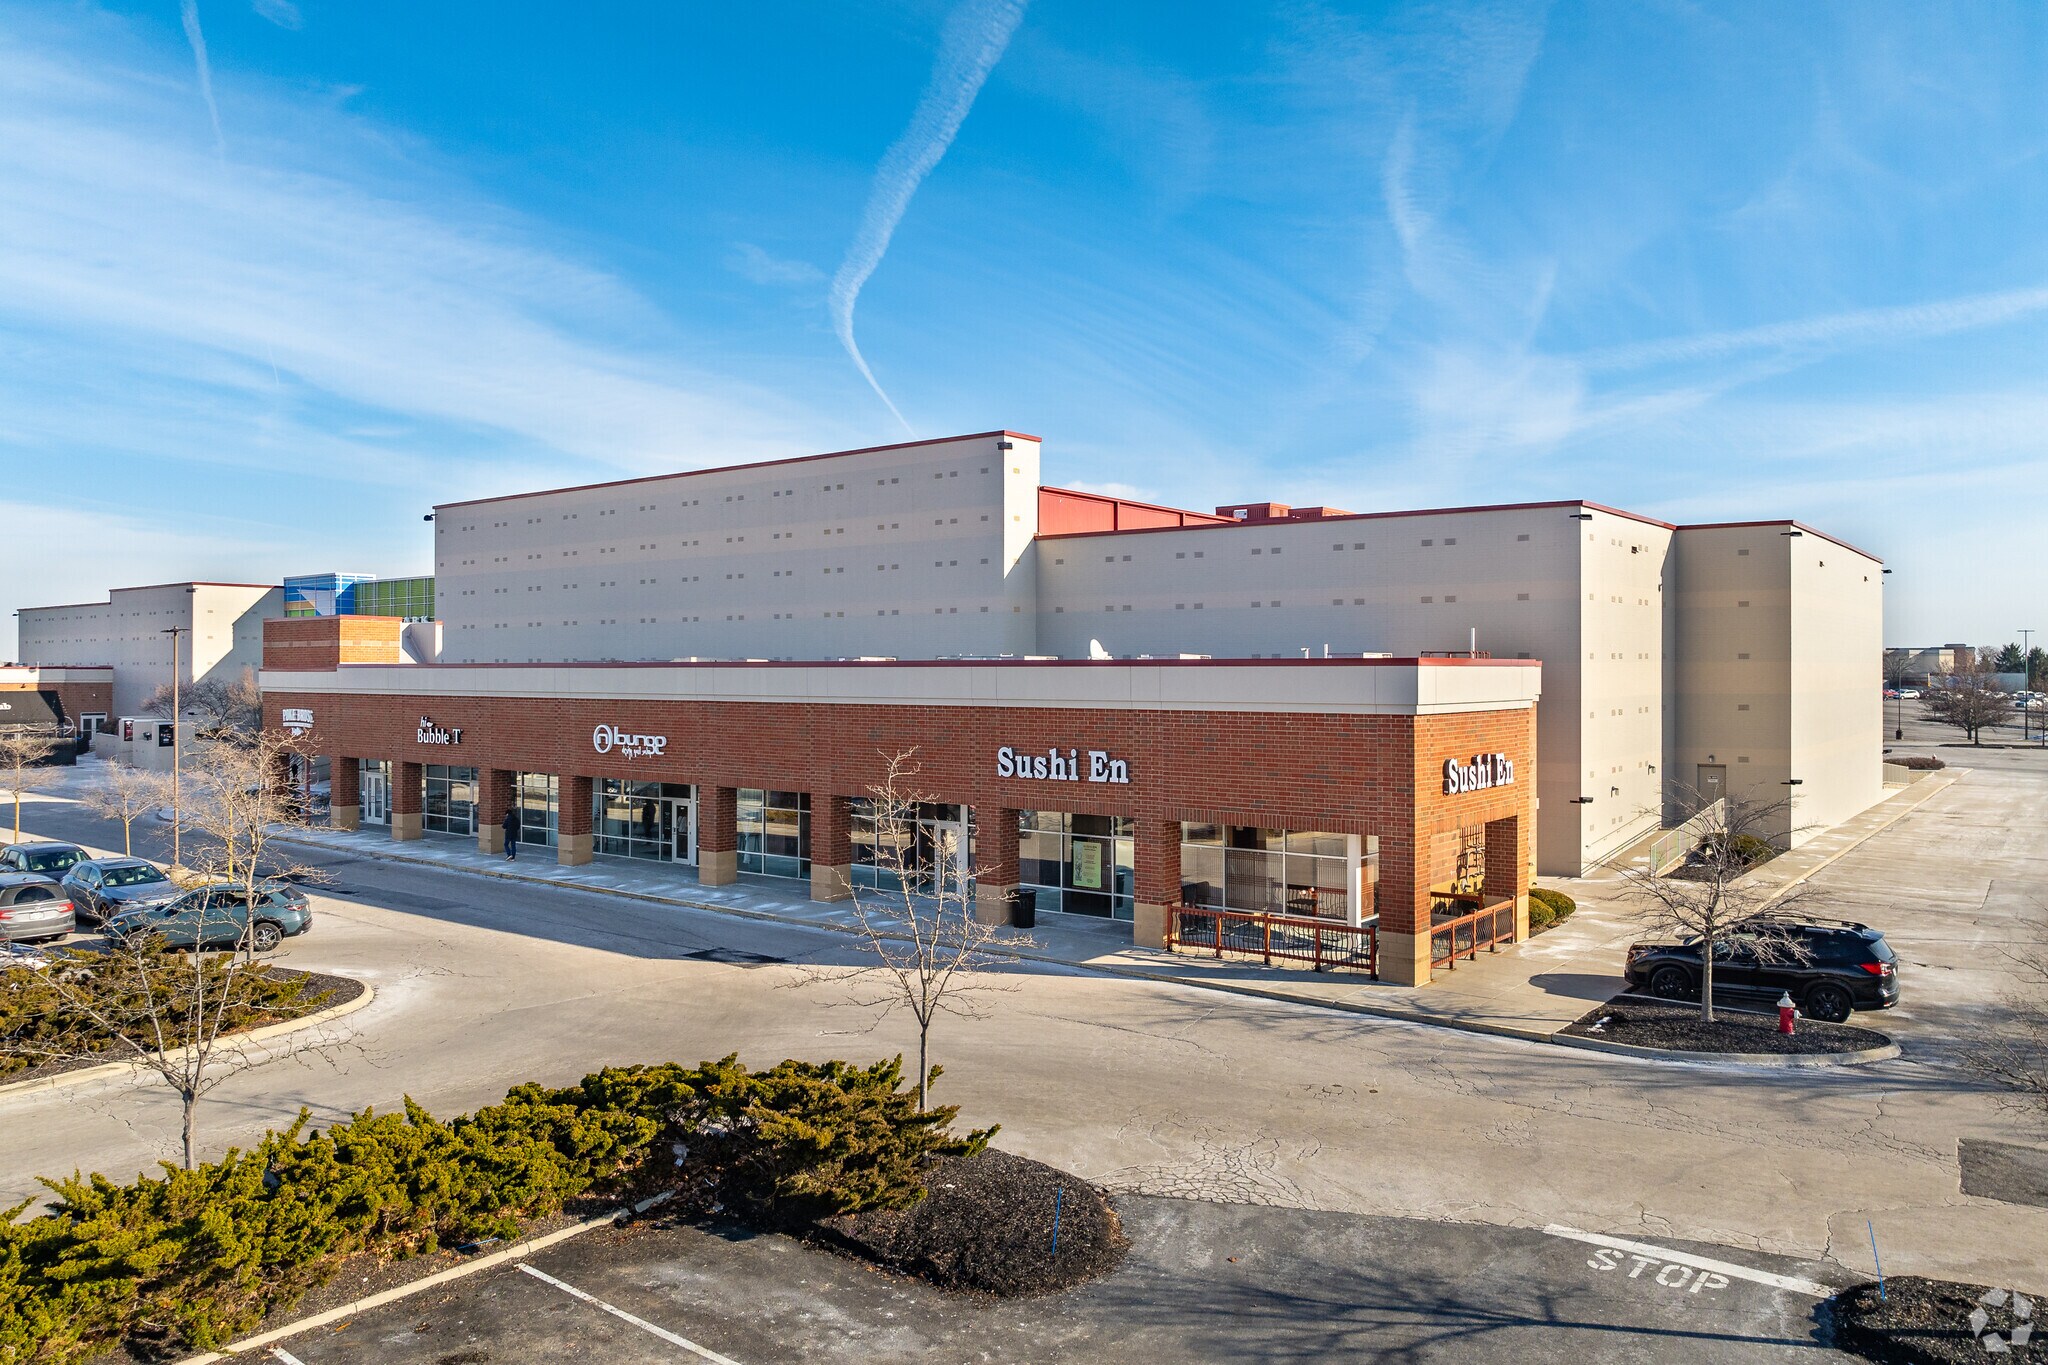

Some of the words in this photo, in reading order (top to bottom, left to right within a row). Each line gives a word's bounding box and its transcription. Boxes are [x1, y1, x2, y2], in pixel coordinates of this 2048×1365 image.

[417, 728, 450, 744] Bubble
[997, 746, 1079, 780] Sushi
[1088, 750, 1129, 783] En
[1448, 753, 1492, 795] Sushi
[1495, 753, 1514, 786] En
[1586, 1249, 1730, 1294] STOP
